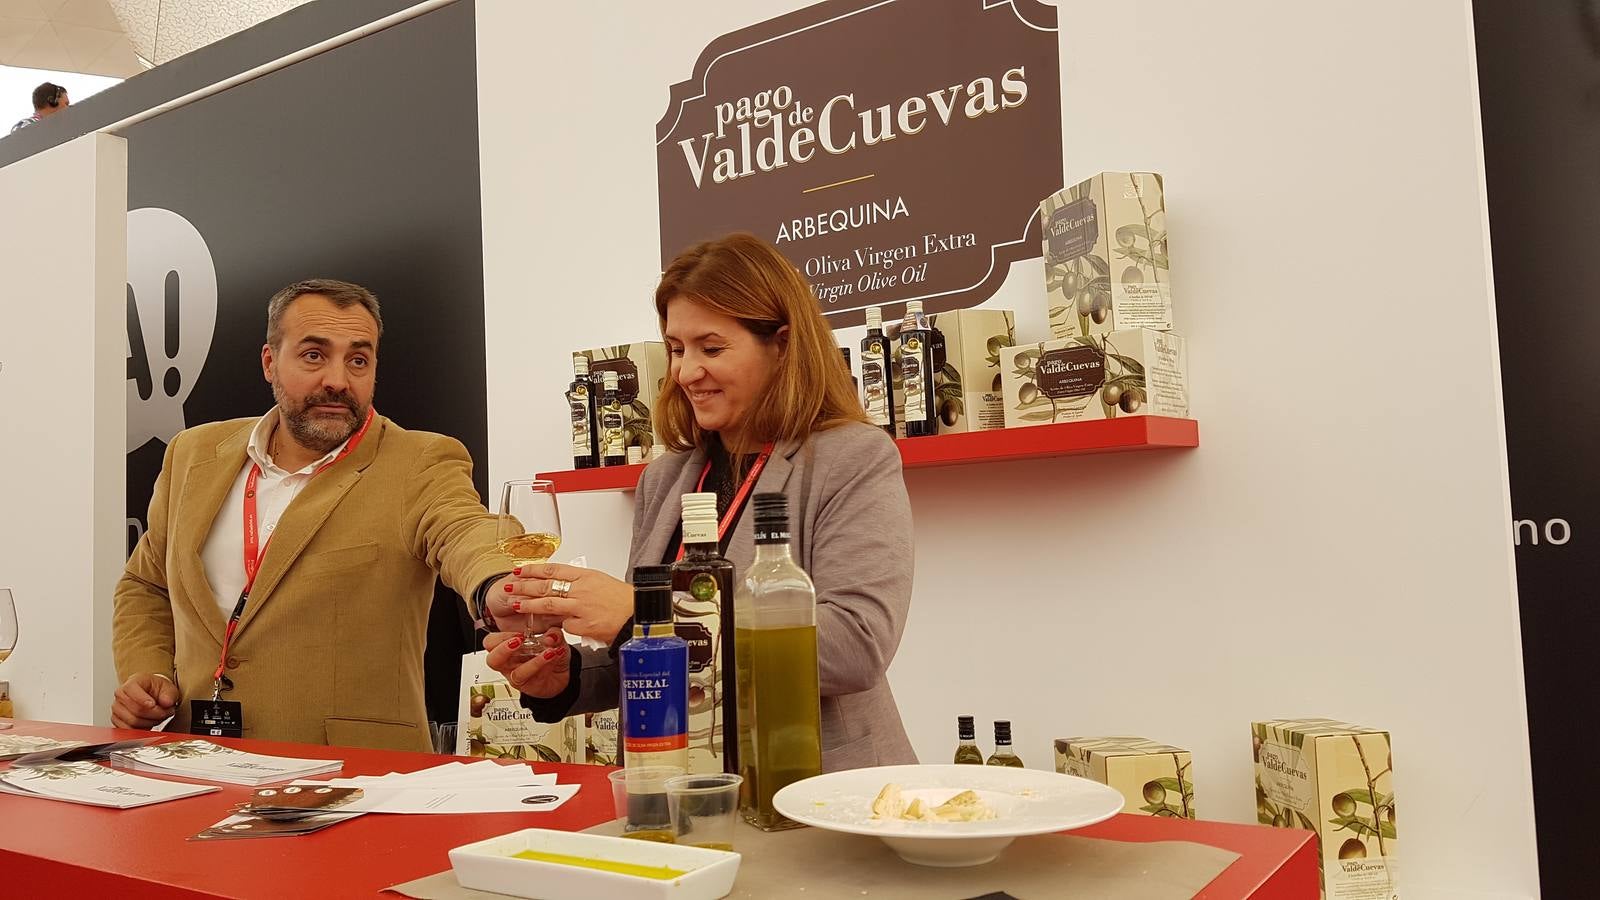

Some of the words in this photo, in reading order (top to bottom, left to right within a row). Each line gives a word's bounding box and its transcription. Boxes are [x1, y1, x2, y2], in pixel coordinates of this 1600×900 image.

[714, 84, 793, 138] pago
[788, 100, 814, 127] de
[677, 65, 1029, 190] ValdeCuevas
[775, 196, 910, 245] ARBEQUINA
[805, 255, 851, 277] Oliva
[855, 244, 917, 270] Virgen
[922, 231, 976, 256] Extra
[857, 272, 897, 293] Olive
[901, 262, 928, 285] Oil
[1040, 361, 1100, 374] ValdeCuevas
[1513, 518, 1571, 546] no
[627, 690, 662, 700] BLAKE
[486, 710, 531, 721] ValdeCue
[1262, 756, 1308, 781] ValdeCuevas
[1342, 863, 1385, 873] ValdeCuevas
